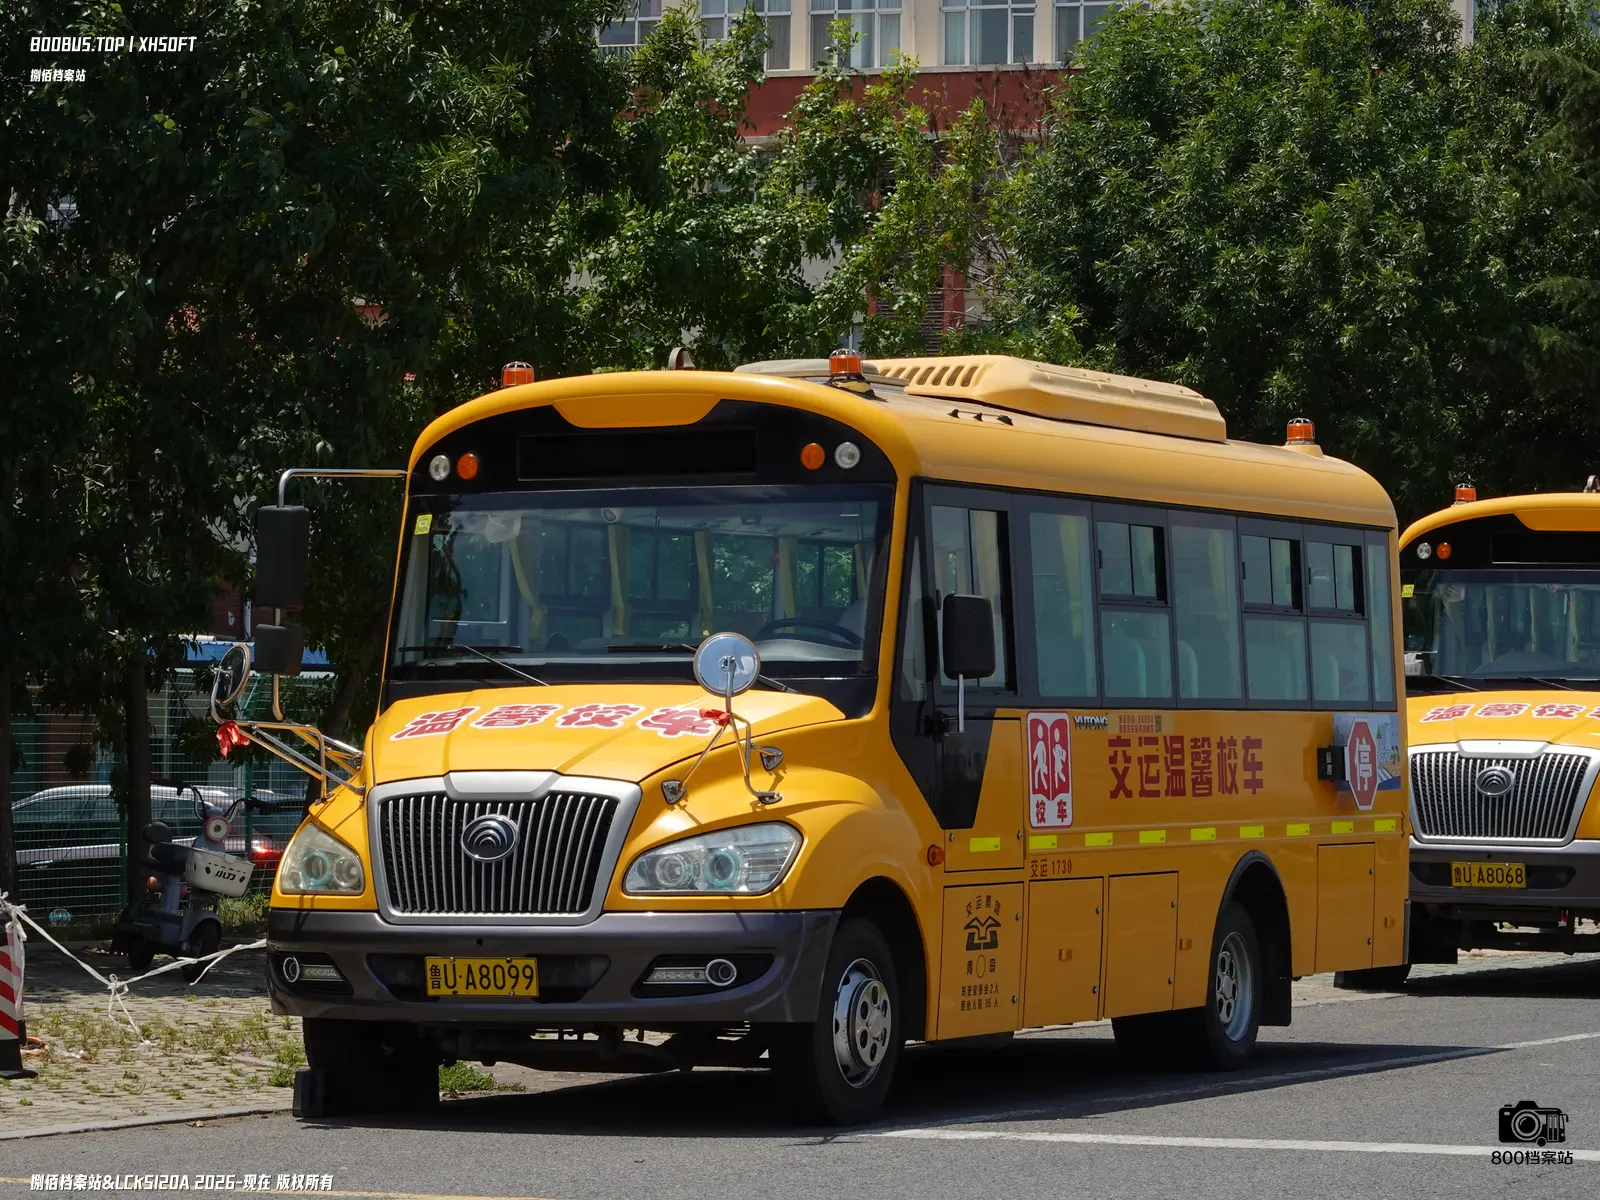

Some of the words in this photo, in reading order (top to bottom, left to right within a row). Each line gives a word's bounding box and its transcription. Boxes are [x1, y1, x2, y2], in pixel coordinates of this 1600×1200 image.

[389, 703, 717, 740] 温馨校车
[1074, 715, 1108, 728] YUTONG
[1421, 703, 1600, 723] 温馨校
[1108, 735, 1264, 799] 交运温馨校车
[1354, 736, 1372, 792] 停
[1030, 859, 1048, 878] 交运
[1052, 858, 1072, 875] 1730
